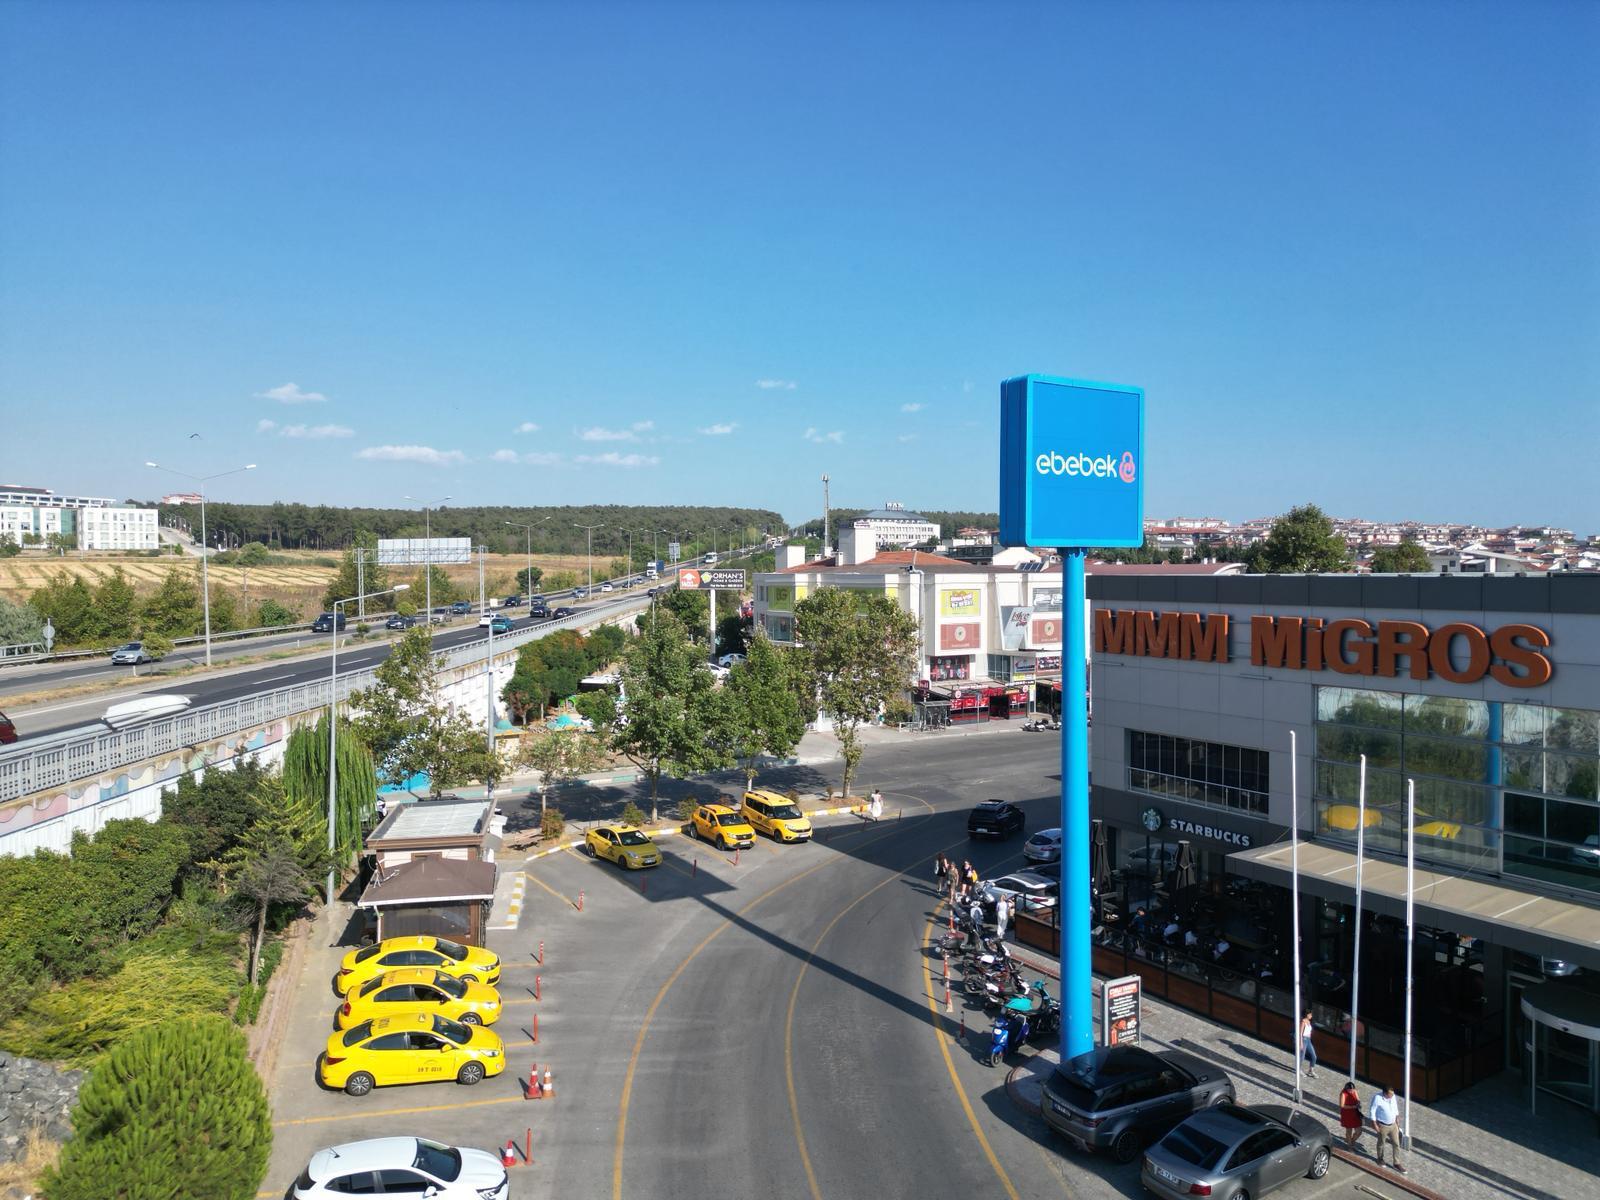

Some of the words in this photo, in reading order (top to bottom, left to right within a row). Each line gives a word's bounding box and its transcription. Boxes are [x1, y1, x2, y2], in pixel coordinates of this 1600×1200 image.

[1035, 450, 1118, 479] ebebek
[1094, 607, 1230, 664] MMM
[1170, 819, 1251, 847] STARBUCKS
